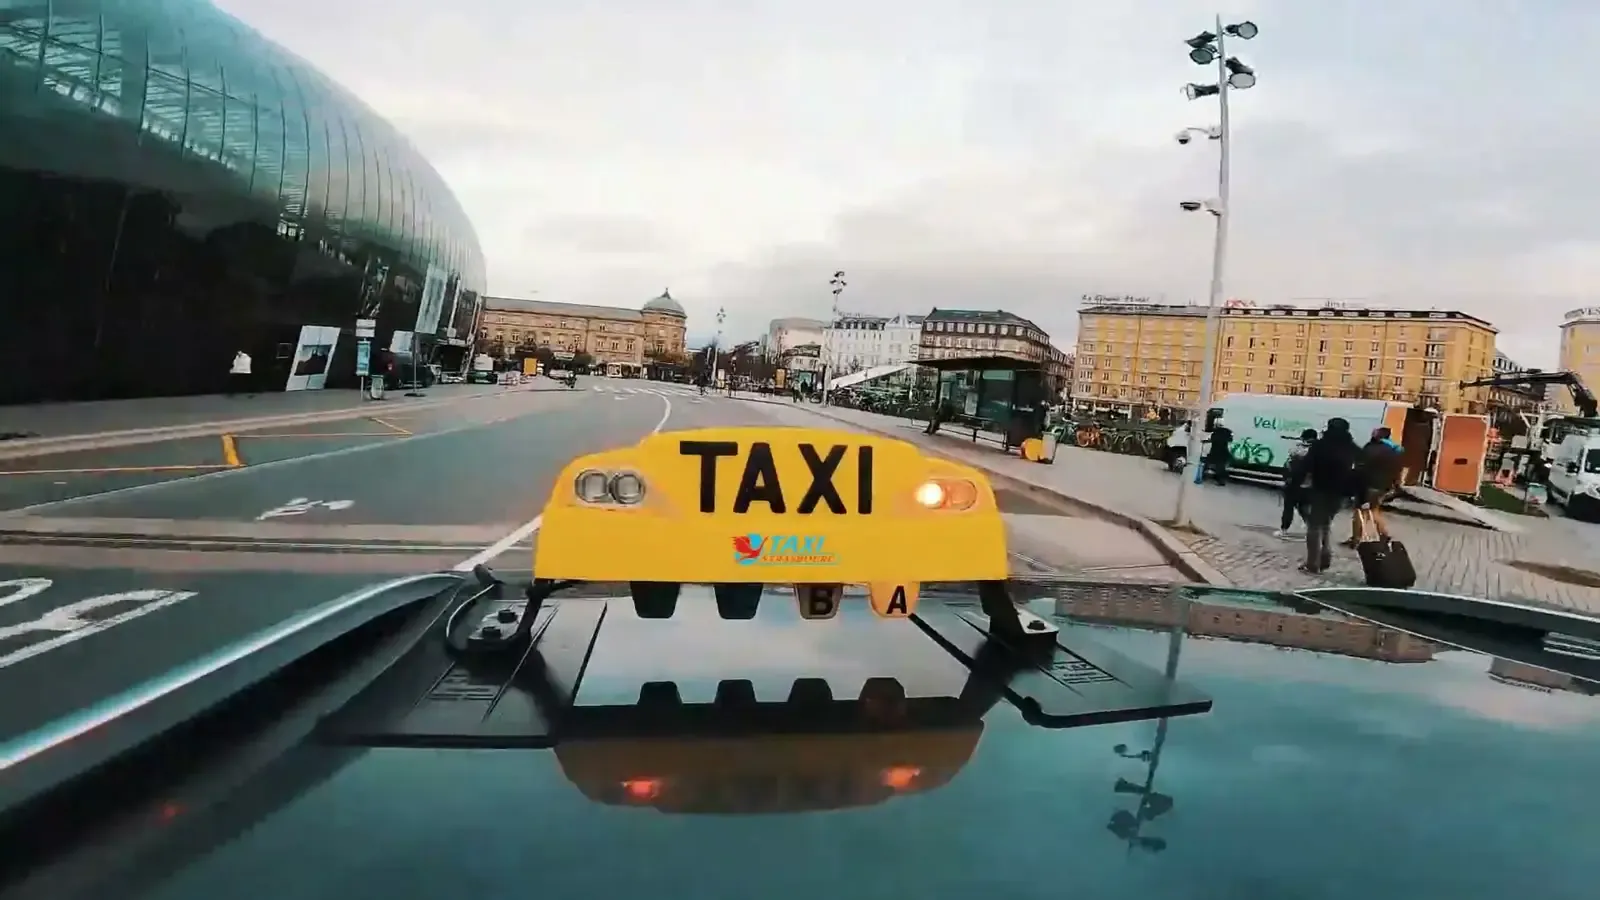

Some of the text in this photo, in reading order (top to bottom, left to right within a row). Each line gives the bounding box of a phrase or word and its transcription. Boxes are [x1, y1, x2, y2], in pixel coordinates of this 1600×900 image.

[679, 440, 874, 515] TAXI
[770, 535, 826, 553] TAXI
[809, 583, 834, 616] B
[886, 585, 908, 615] A
